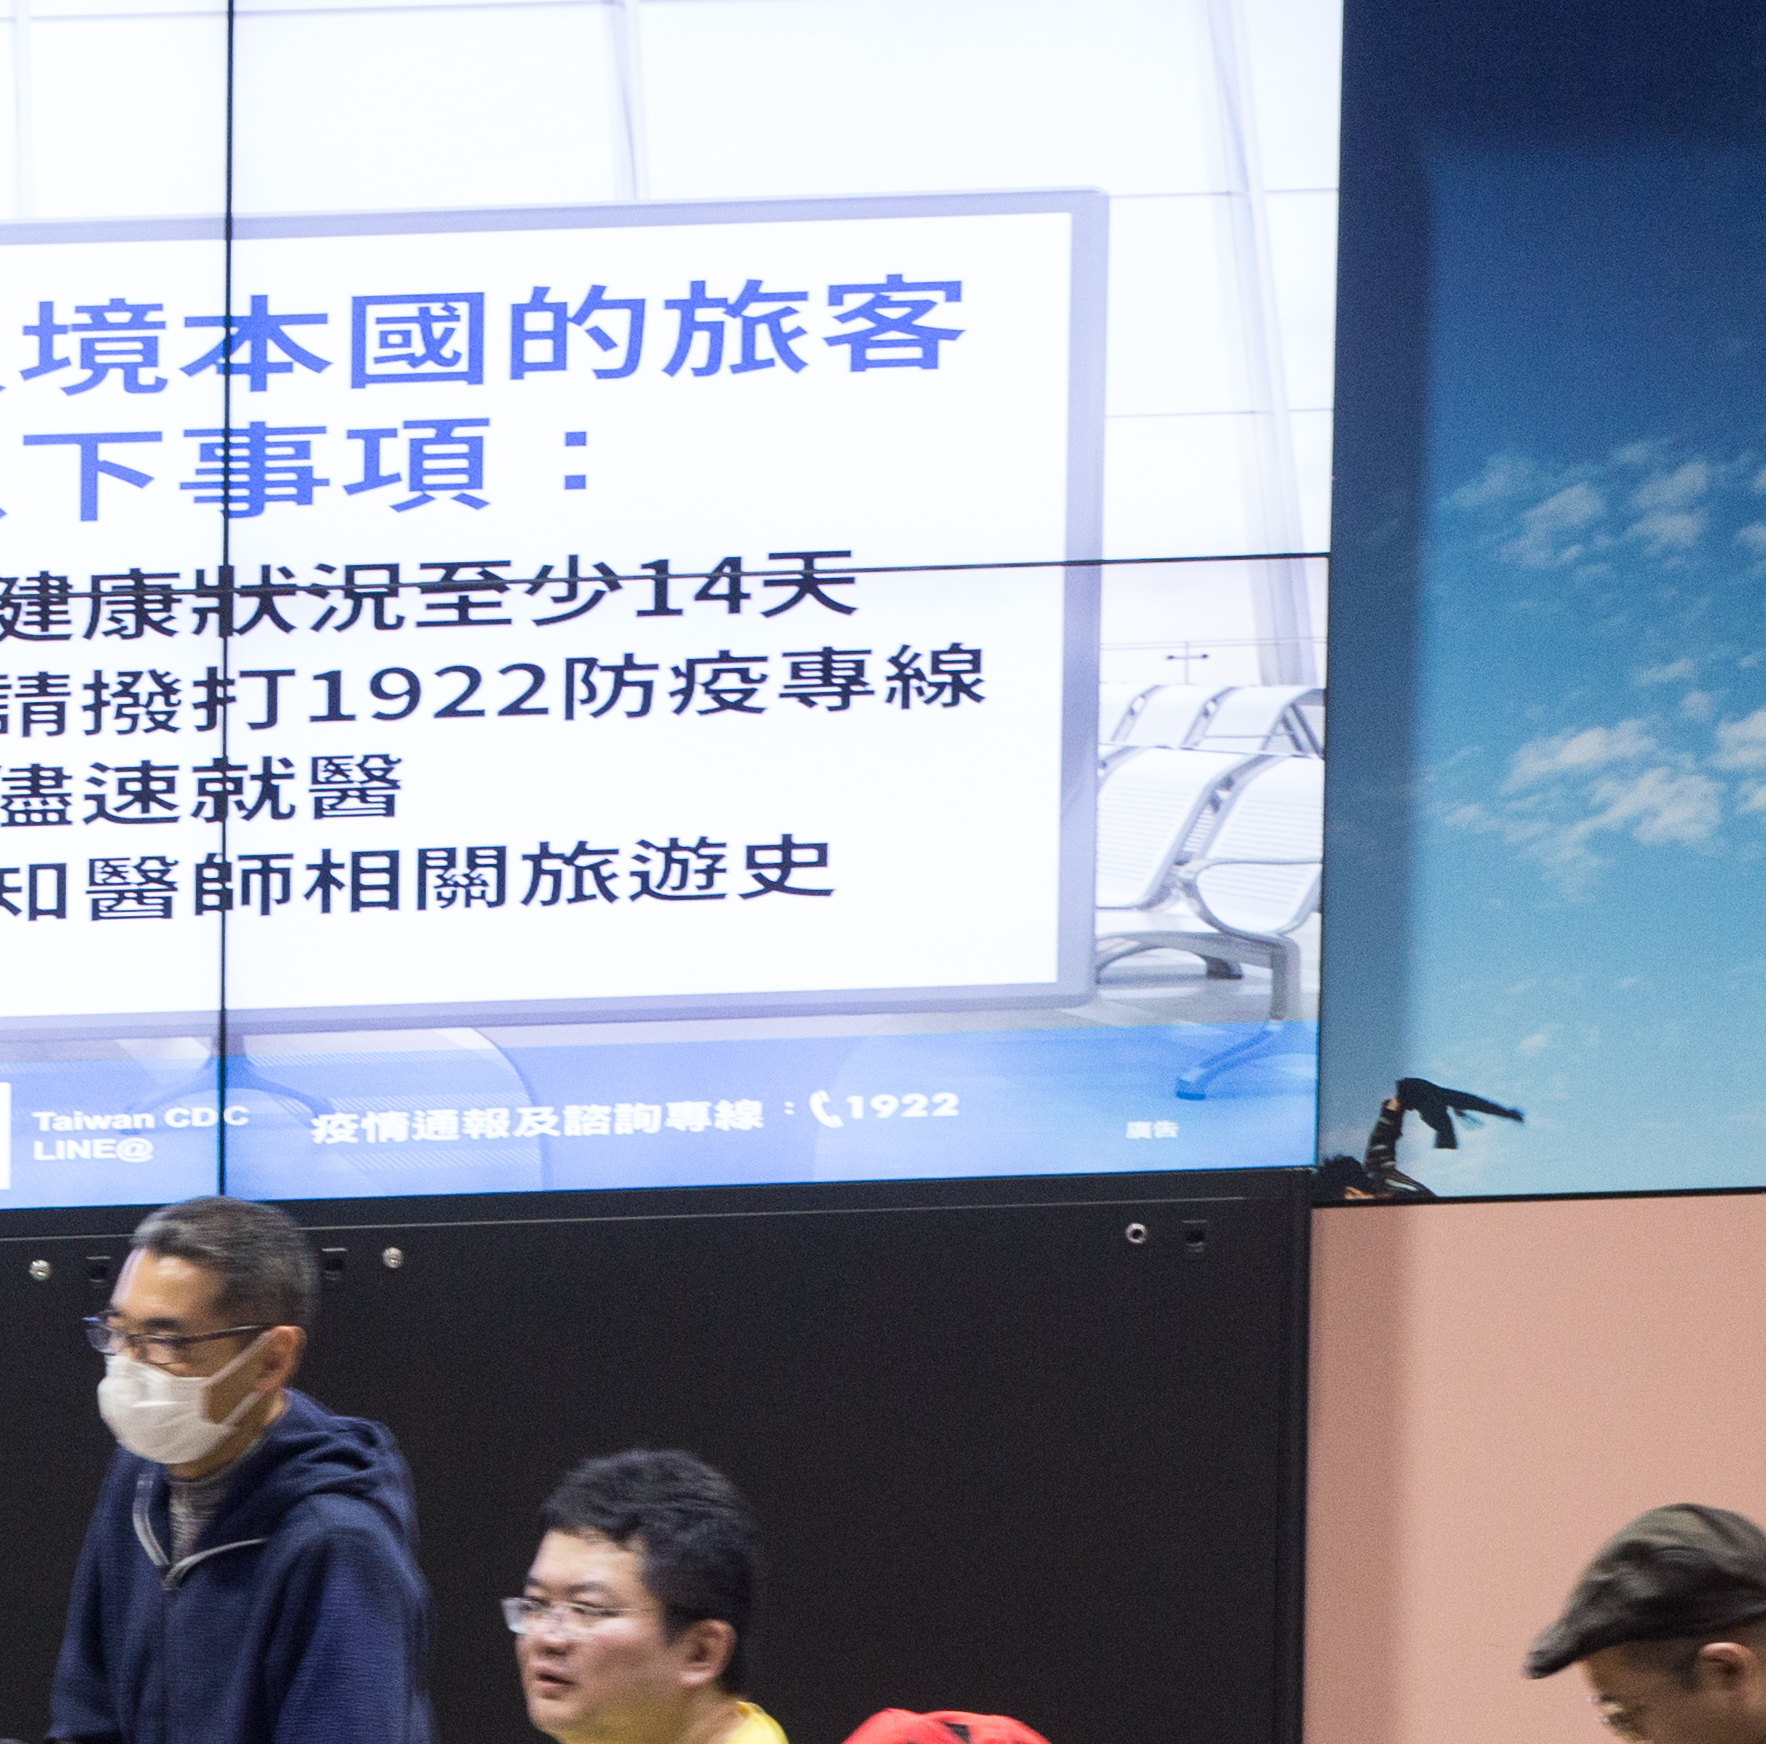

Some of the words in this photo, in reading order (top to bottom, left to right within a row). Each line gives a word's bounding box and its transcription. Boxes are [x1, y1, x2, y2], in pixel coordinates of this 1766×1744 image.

[32, 1109, 156, 1133] Taiwan
[164, 1105, 251, 1130] CDC
[845, 1092, 961, 1120] 1922
[33, 1137, 155, 1164] LINE@
